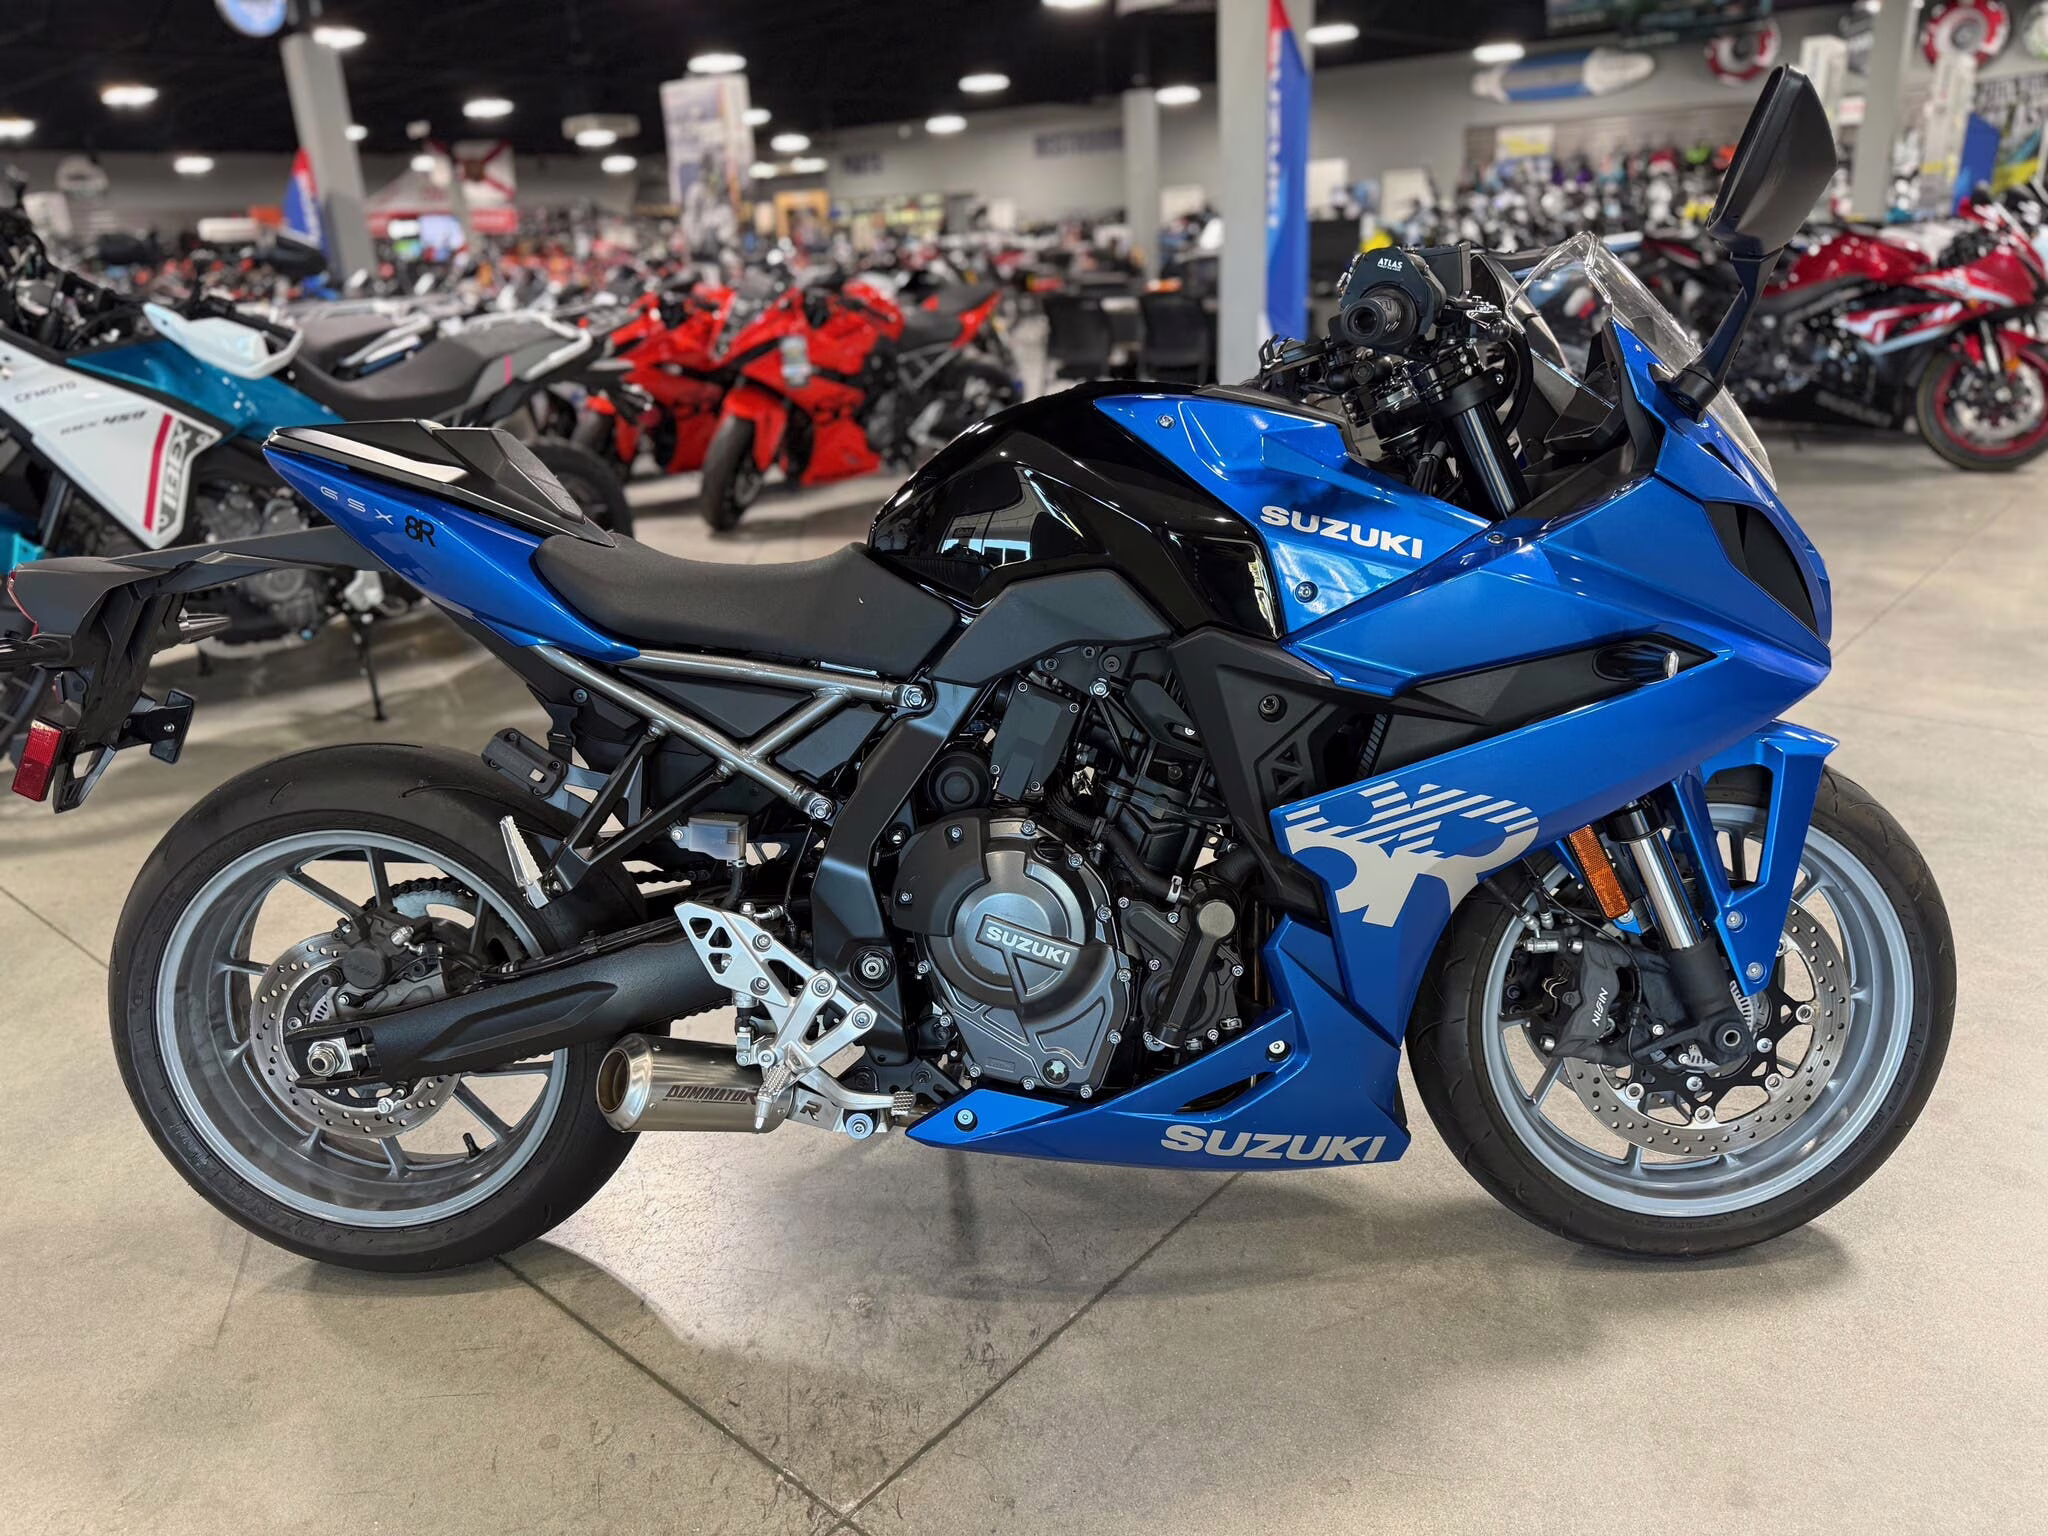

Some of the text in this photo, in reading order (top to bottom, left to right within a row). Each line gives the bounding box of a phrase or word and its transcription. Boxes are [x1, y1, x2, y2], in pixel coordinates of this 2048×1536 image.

[1377, 257, 1403, 269] ATLAS
[14, 381, 77, 403] CFMOTO
[404, 514, 436, 548] 8R
[1261, 505, 1423, 560] SUZUKI
[986, 926, 1070, 966] SUZUKI
[1592, 987, 1609, 1027] NISSIN
[664, 1084, 758, 1106] DOMINATOR
[1160, 1124, 1387, 1162] SUZUKI
